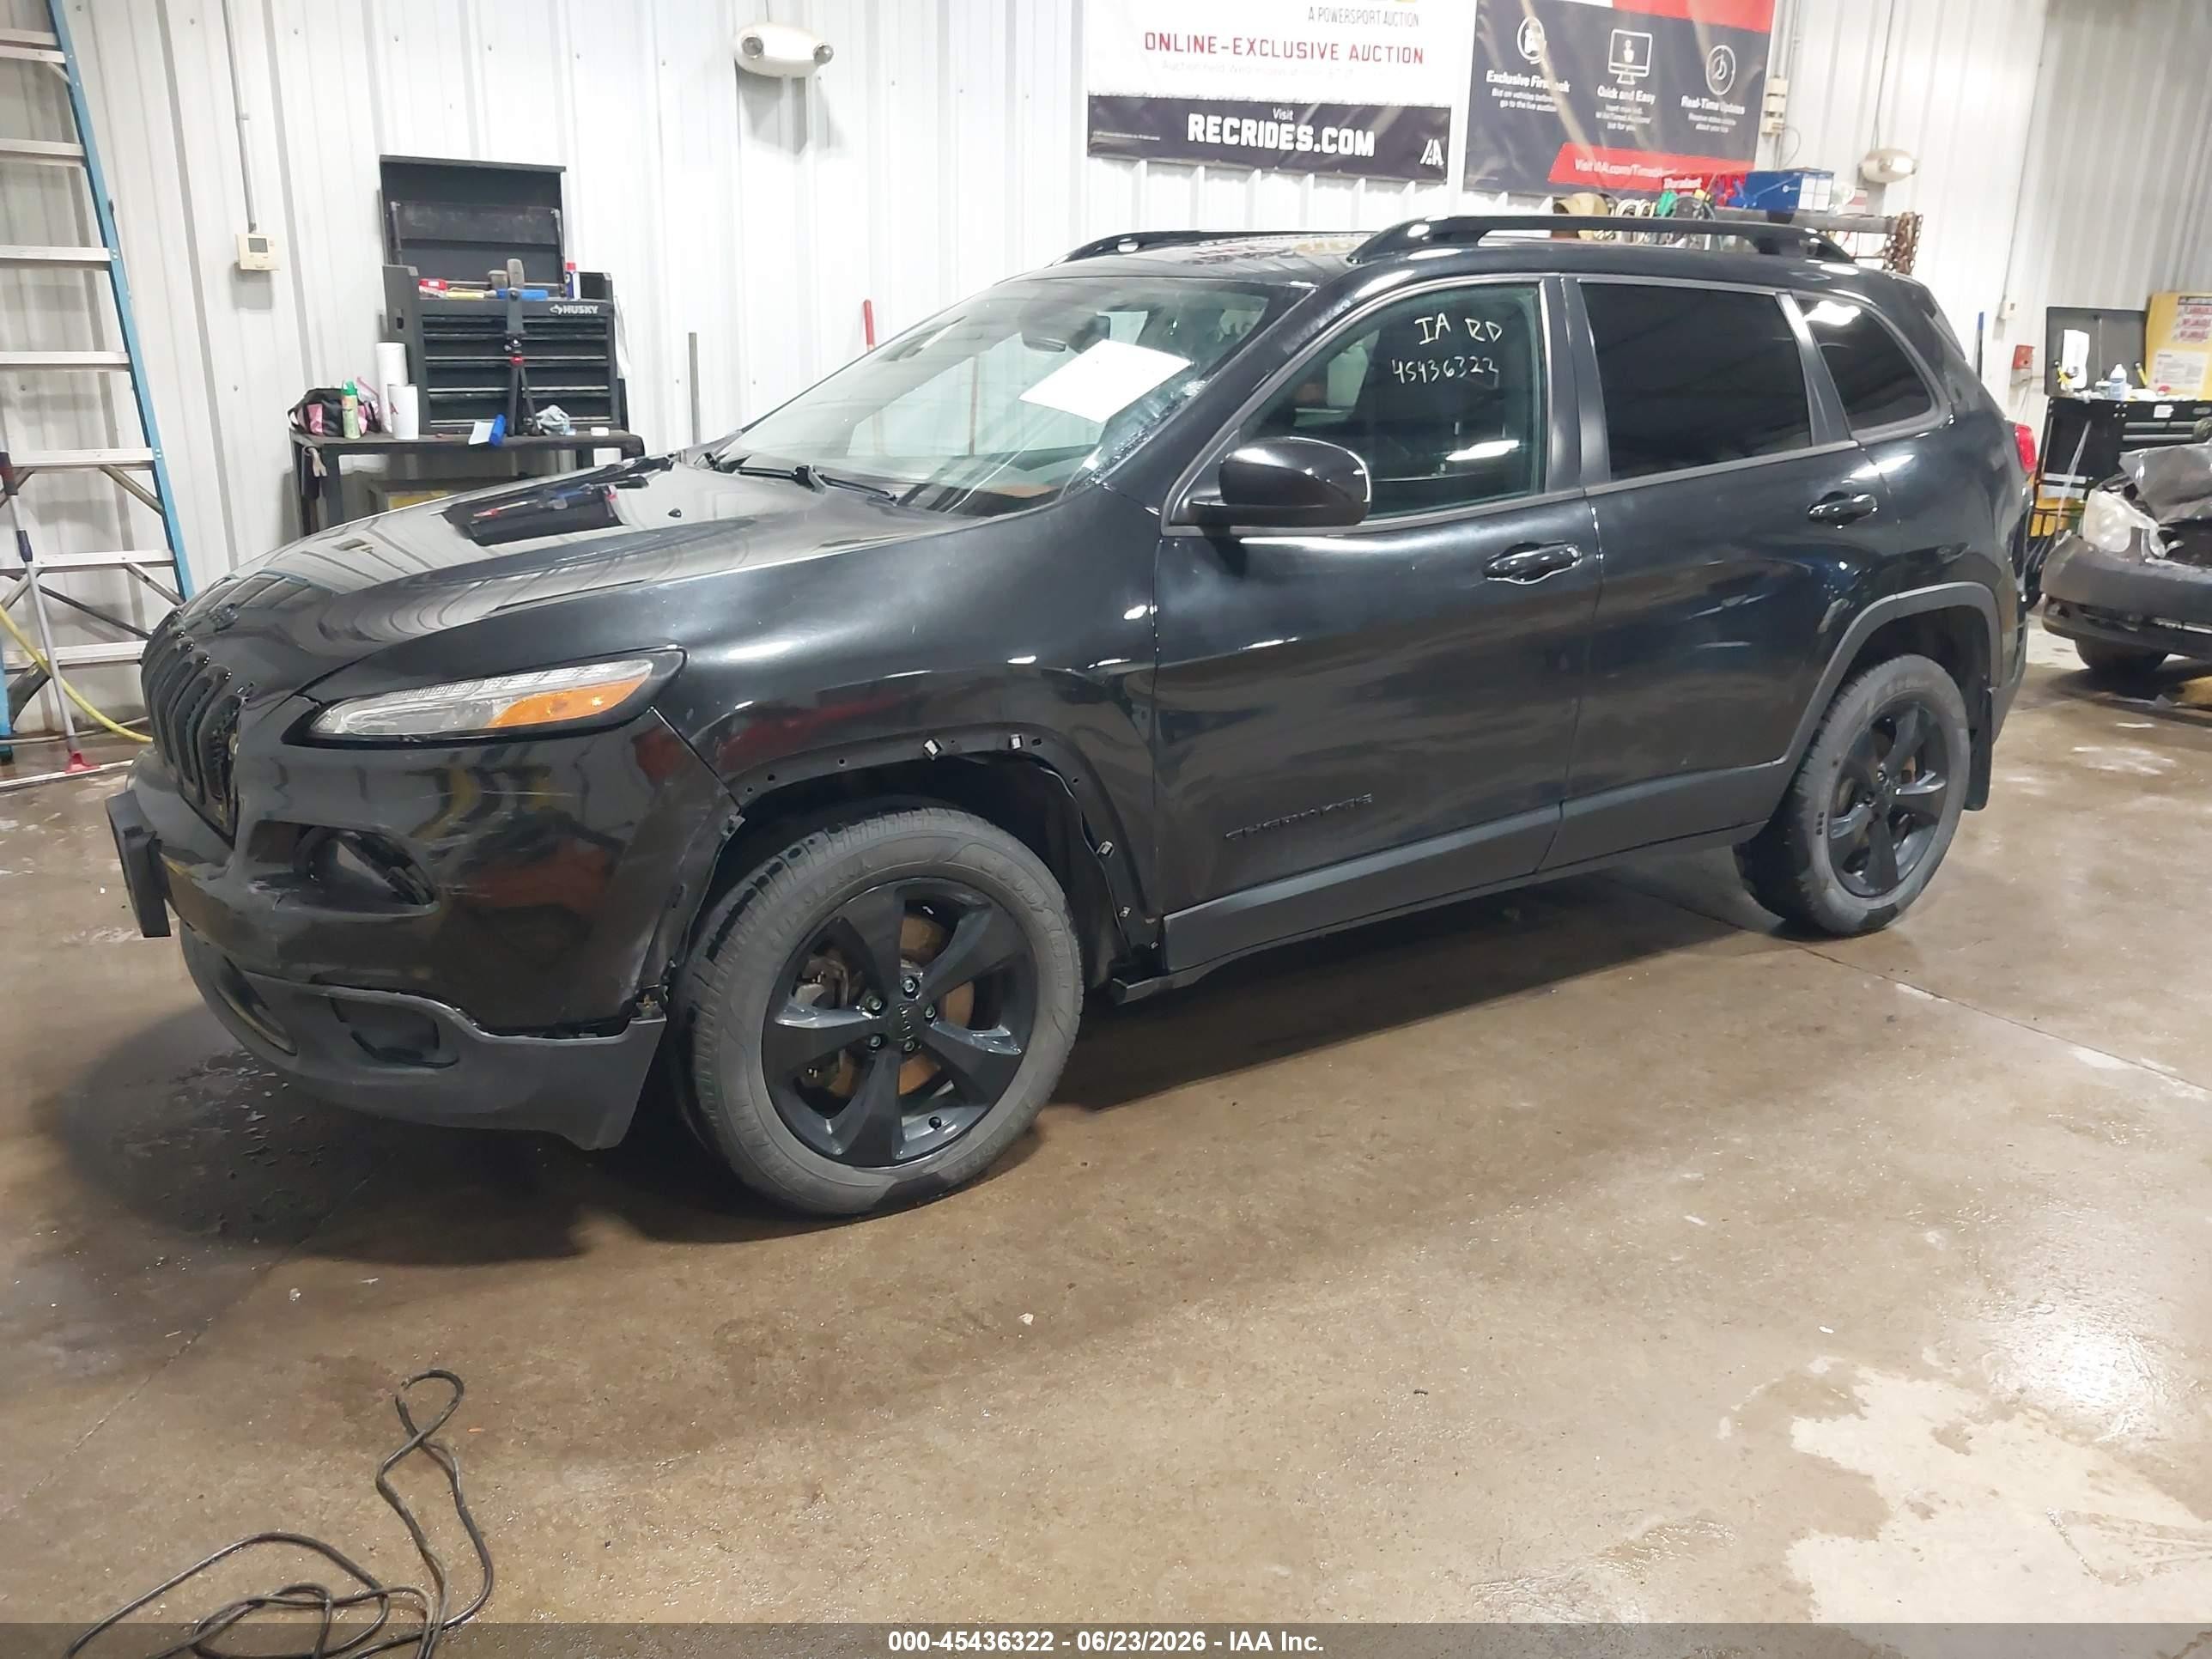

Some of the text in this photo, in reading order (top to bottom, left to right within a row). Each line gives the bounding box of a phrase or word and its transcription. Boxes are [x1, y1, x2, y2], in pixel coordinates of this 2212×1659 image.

[1308, 6, 1419, 27] A POWERSPORT AUCTION
[1145, 31, 1424, 64] ONLINE-EXCLUSIVE AUCTION
[1486, 70, 1530, 87] Exclusive
[1597, 85, 1656, 105] Quick and Easy
[1273, 106, 1295, 122] Visit
[1187, 112, 1375, 158] RECRIDES.COM
[562, 305, 599, 314] HUSKY
[1414, 312, 1503, 345] IA RD
